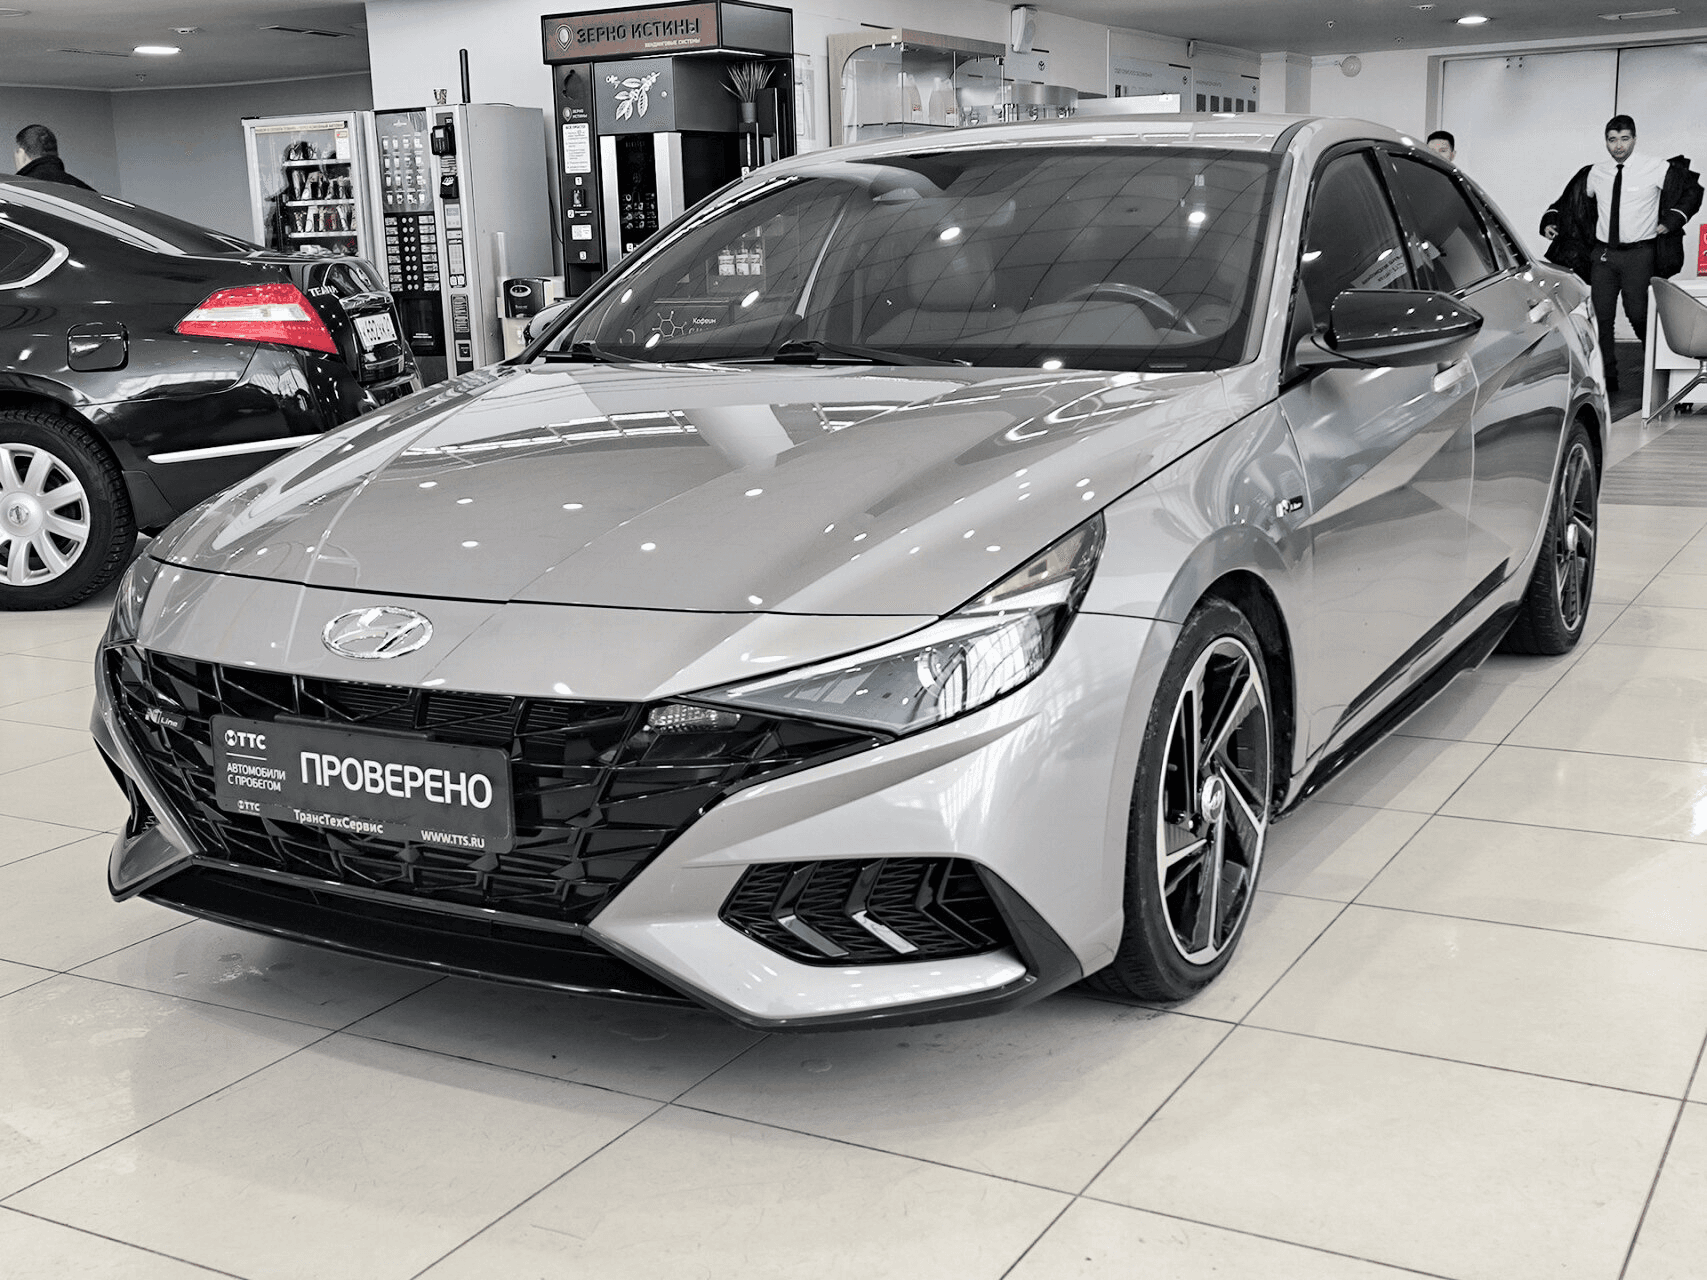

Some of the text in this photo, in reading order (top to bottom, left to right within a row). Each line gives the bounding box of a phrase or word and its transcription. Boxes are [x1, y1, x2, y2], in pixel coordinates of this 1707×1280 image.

[576, 18, 699, 44] ЗЕРНО ИСТИНЫ
[238, 731, 267, 750] ТТС
[226, 762, 286, 781] АВТОМОБИЛИ
[300, 751, 493, 809] ПРОВЕРЕНО
[227, 774, 281, 792] С ПРОБЕГОМ
[293, 808, 384, 835] ТрансТехСервис
[421, 829, 485, 849] WWW.TTS.RU
